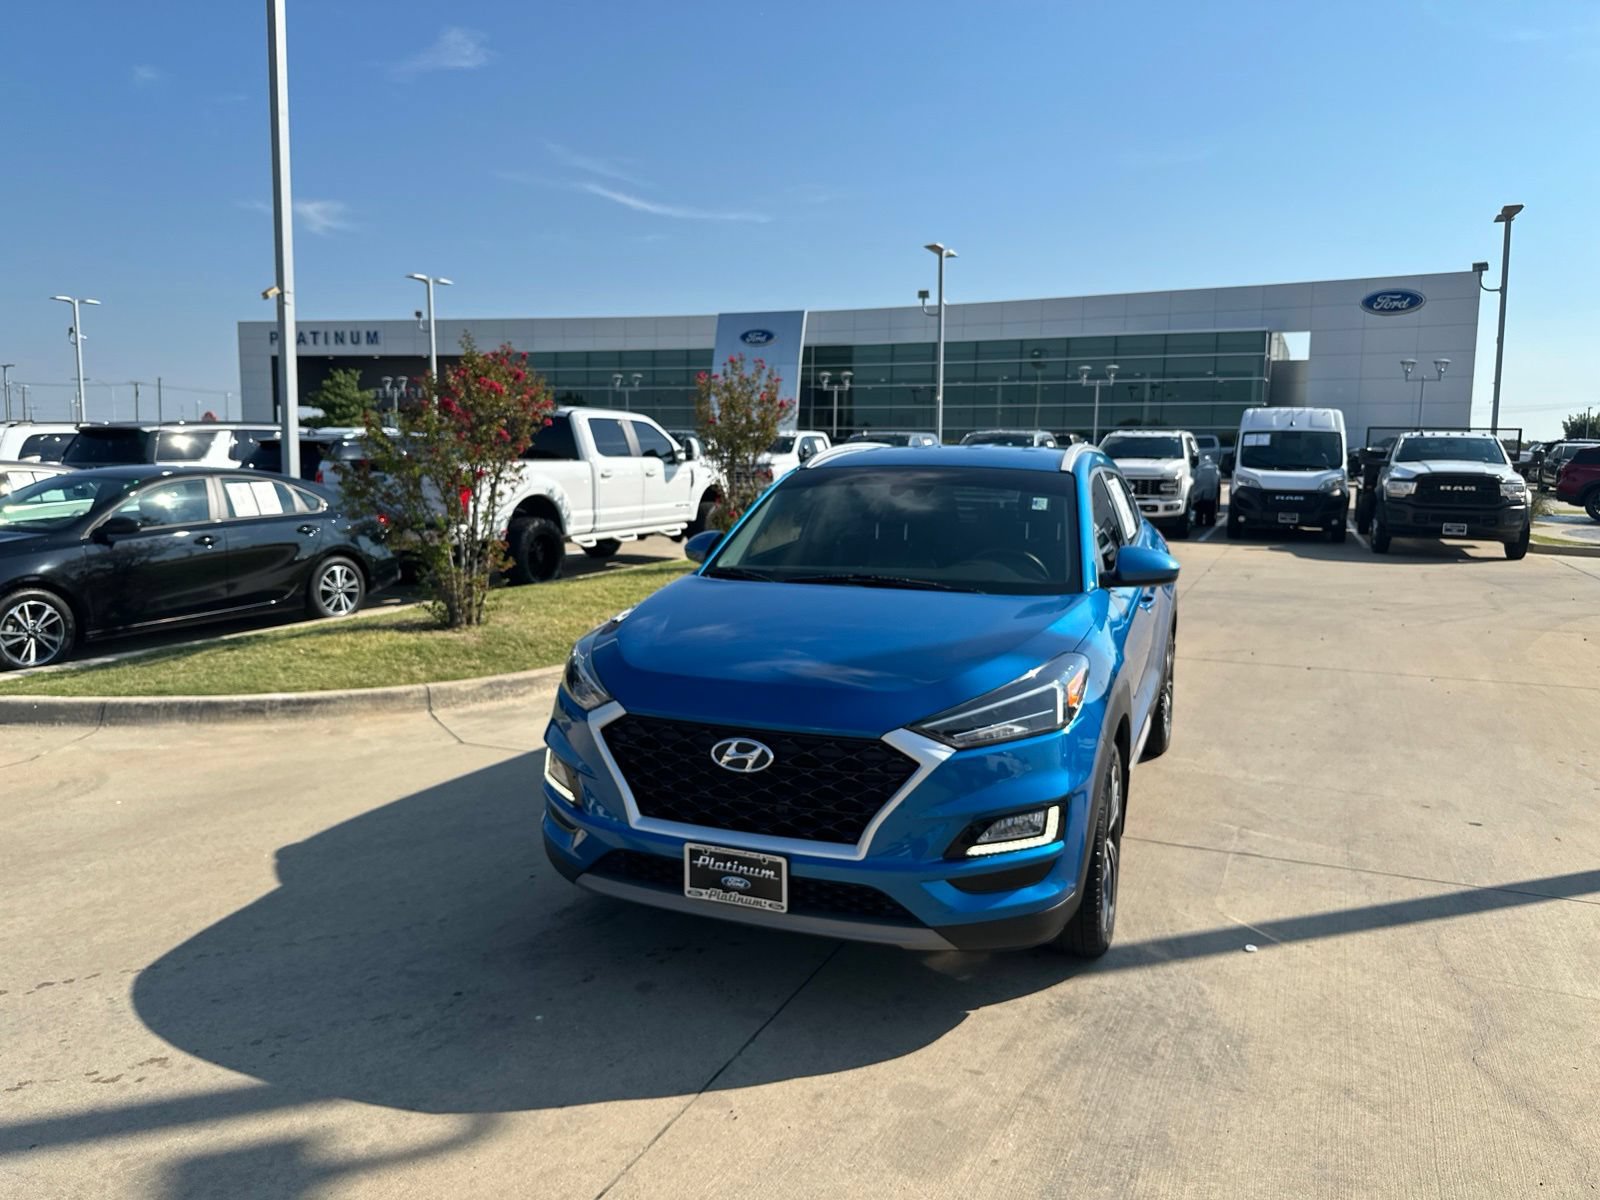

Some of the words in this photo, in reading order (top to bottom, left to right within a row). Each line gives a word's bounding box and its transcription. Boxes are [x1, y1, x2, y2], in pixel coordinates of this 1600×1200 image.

[1373, 295, 1410, 310] Ford
[269, 330, 380, 345] PATINUM
[692, 855, 779, 880] Platinum
[708, 889, 767, 908] Platinum
